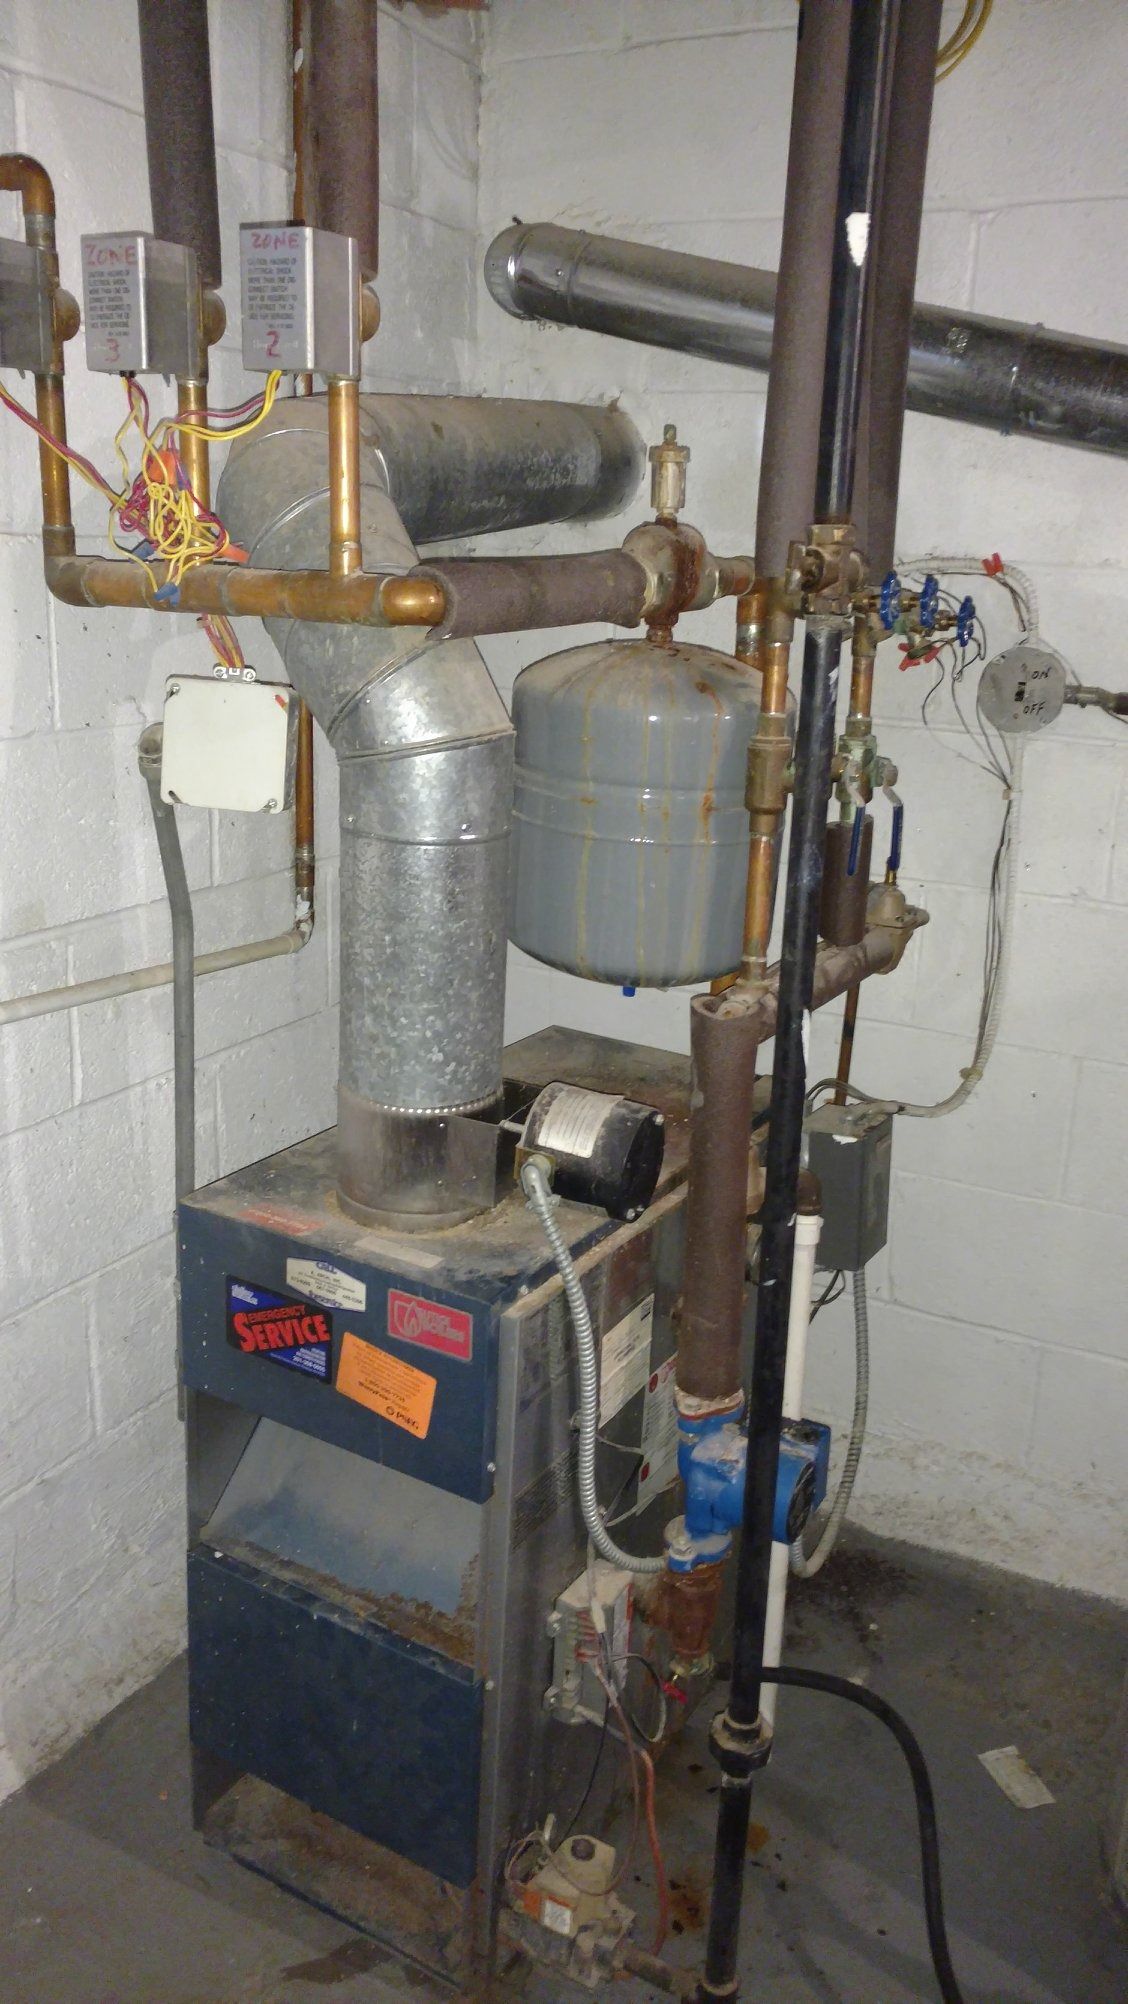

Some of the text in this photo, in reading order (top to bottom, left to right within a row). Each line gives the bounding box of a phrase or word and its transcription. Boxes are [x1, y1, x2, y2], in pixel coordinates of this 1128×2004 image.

[251, 231, 300, 250] ZONE
[84, 244, 137, 267] ZONE
[104, 338, 121, 362] 3
[266, 330, 283, 358] 2
[1031, 666, 1052, 680] ON
[1023, 701, 1046, 716] OFF
[247, 1304, 306, 1324] EMERGENCY
[233, 1312, 331, 1353] SERVICE
